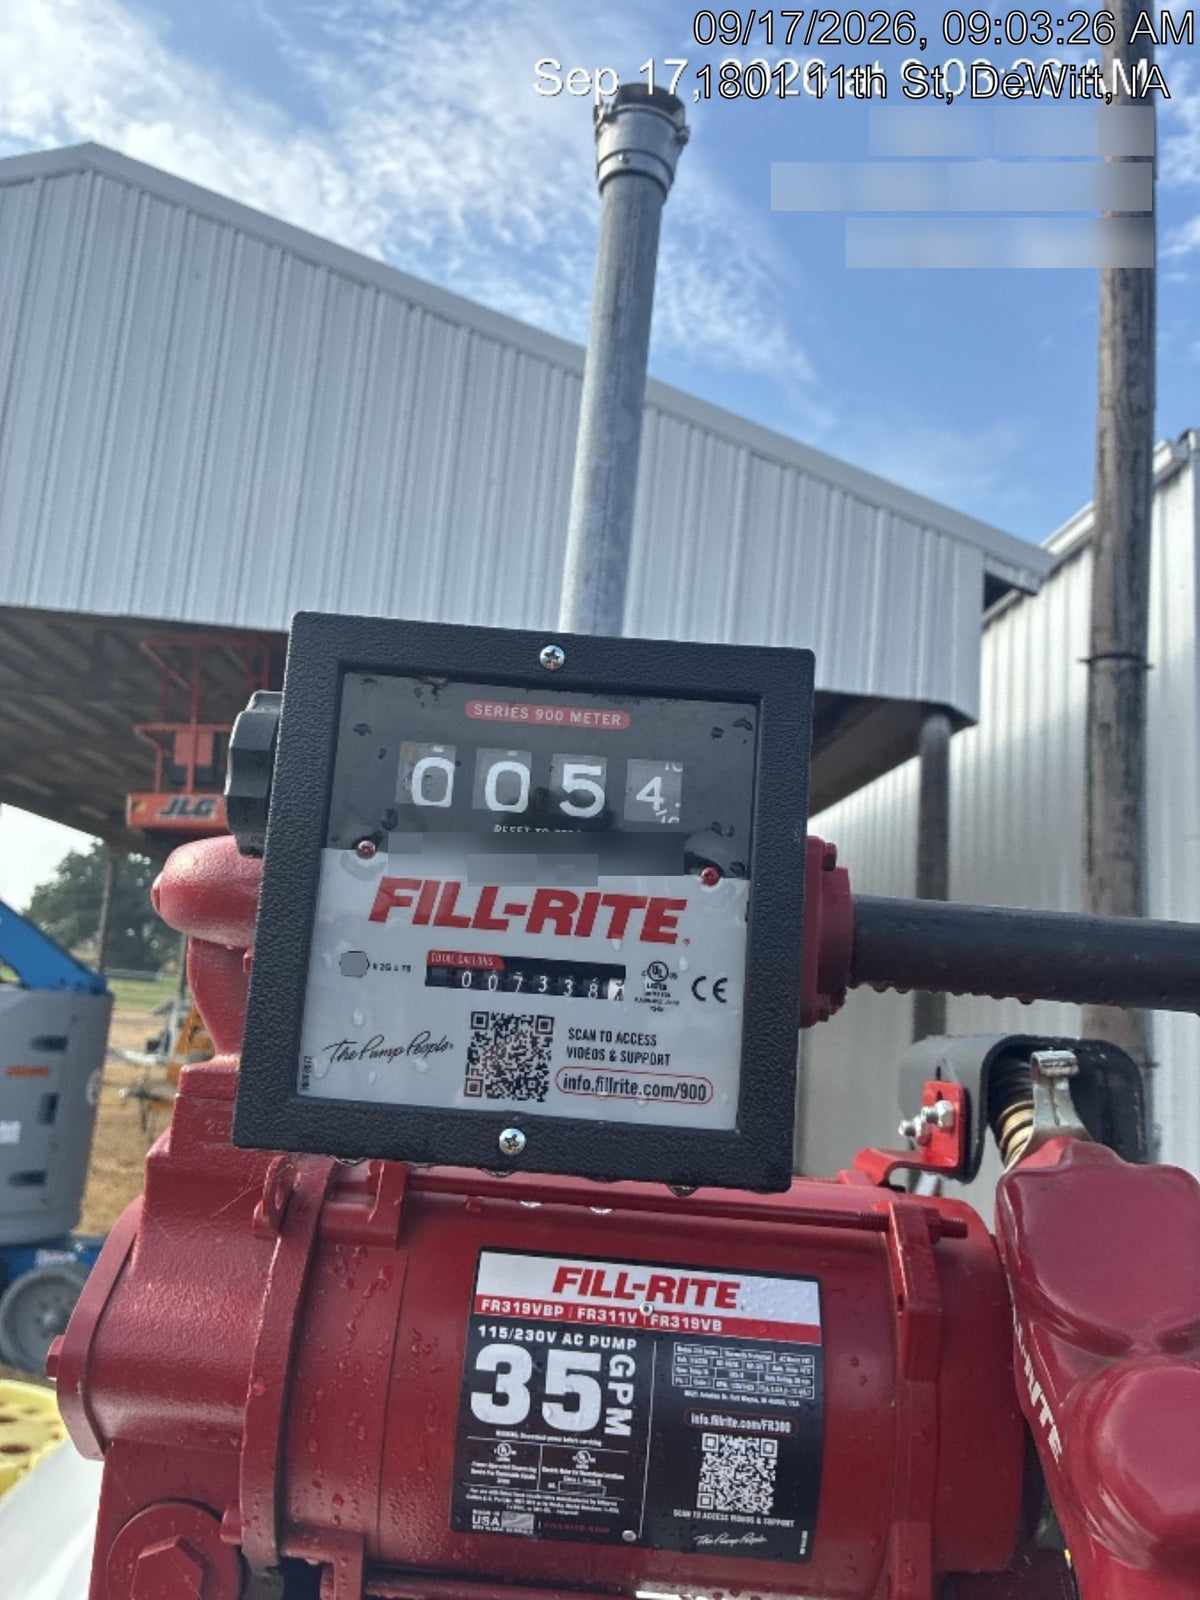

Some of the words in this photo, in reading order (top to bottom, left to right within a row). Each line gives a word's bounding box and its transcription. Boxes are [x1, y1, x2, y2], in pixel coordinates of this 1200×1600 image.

[474, 703, 528, 719] SERIES
[535, 708, 564, 721] 900
[570, 711, 621, 725] METER
[158, 796, 217, 818] JLG
[368, 875, 688, 945] FILL-RITE
[321, 1038, 357, 1064] The
[358, 1034, 404, 1063] Pump
[406, 1030, 449, 1058] People
[568, 1027, 597, 1042] SCAN
[600, 1031, 613, 1043] TO
[615, 1032, 657, 1047] ACCESS
[566, 1046, 606, 1061] VIDEOS
[609, 1050, 617, 1062] &
[620, 1050, 671, 1066] SUPPORT
[562, 1073, 707, 1101] info.fillrite.com/900
[552, 1266, 741, 1310] FILL-RITE
[480, 1299, 564, 1317] FR319VBP
[577, 1309, 638, 1324] FR311V
[650, 1314, 723, 1332] FR319VB
[478, 1325, 556, 1344] 115/230V
[561, 1333, 584, 1347] AC
[589, 1335, 637, 1351] PUMP
[470, 1343, 602, 1433] 35
[604, 1353, 637, 1437] GPM
[472, 1514, 501, 1527] USA
[702, 1512, 730, 1521] ACCESS
